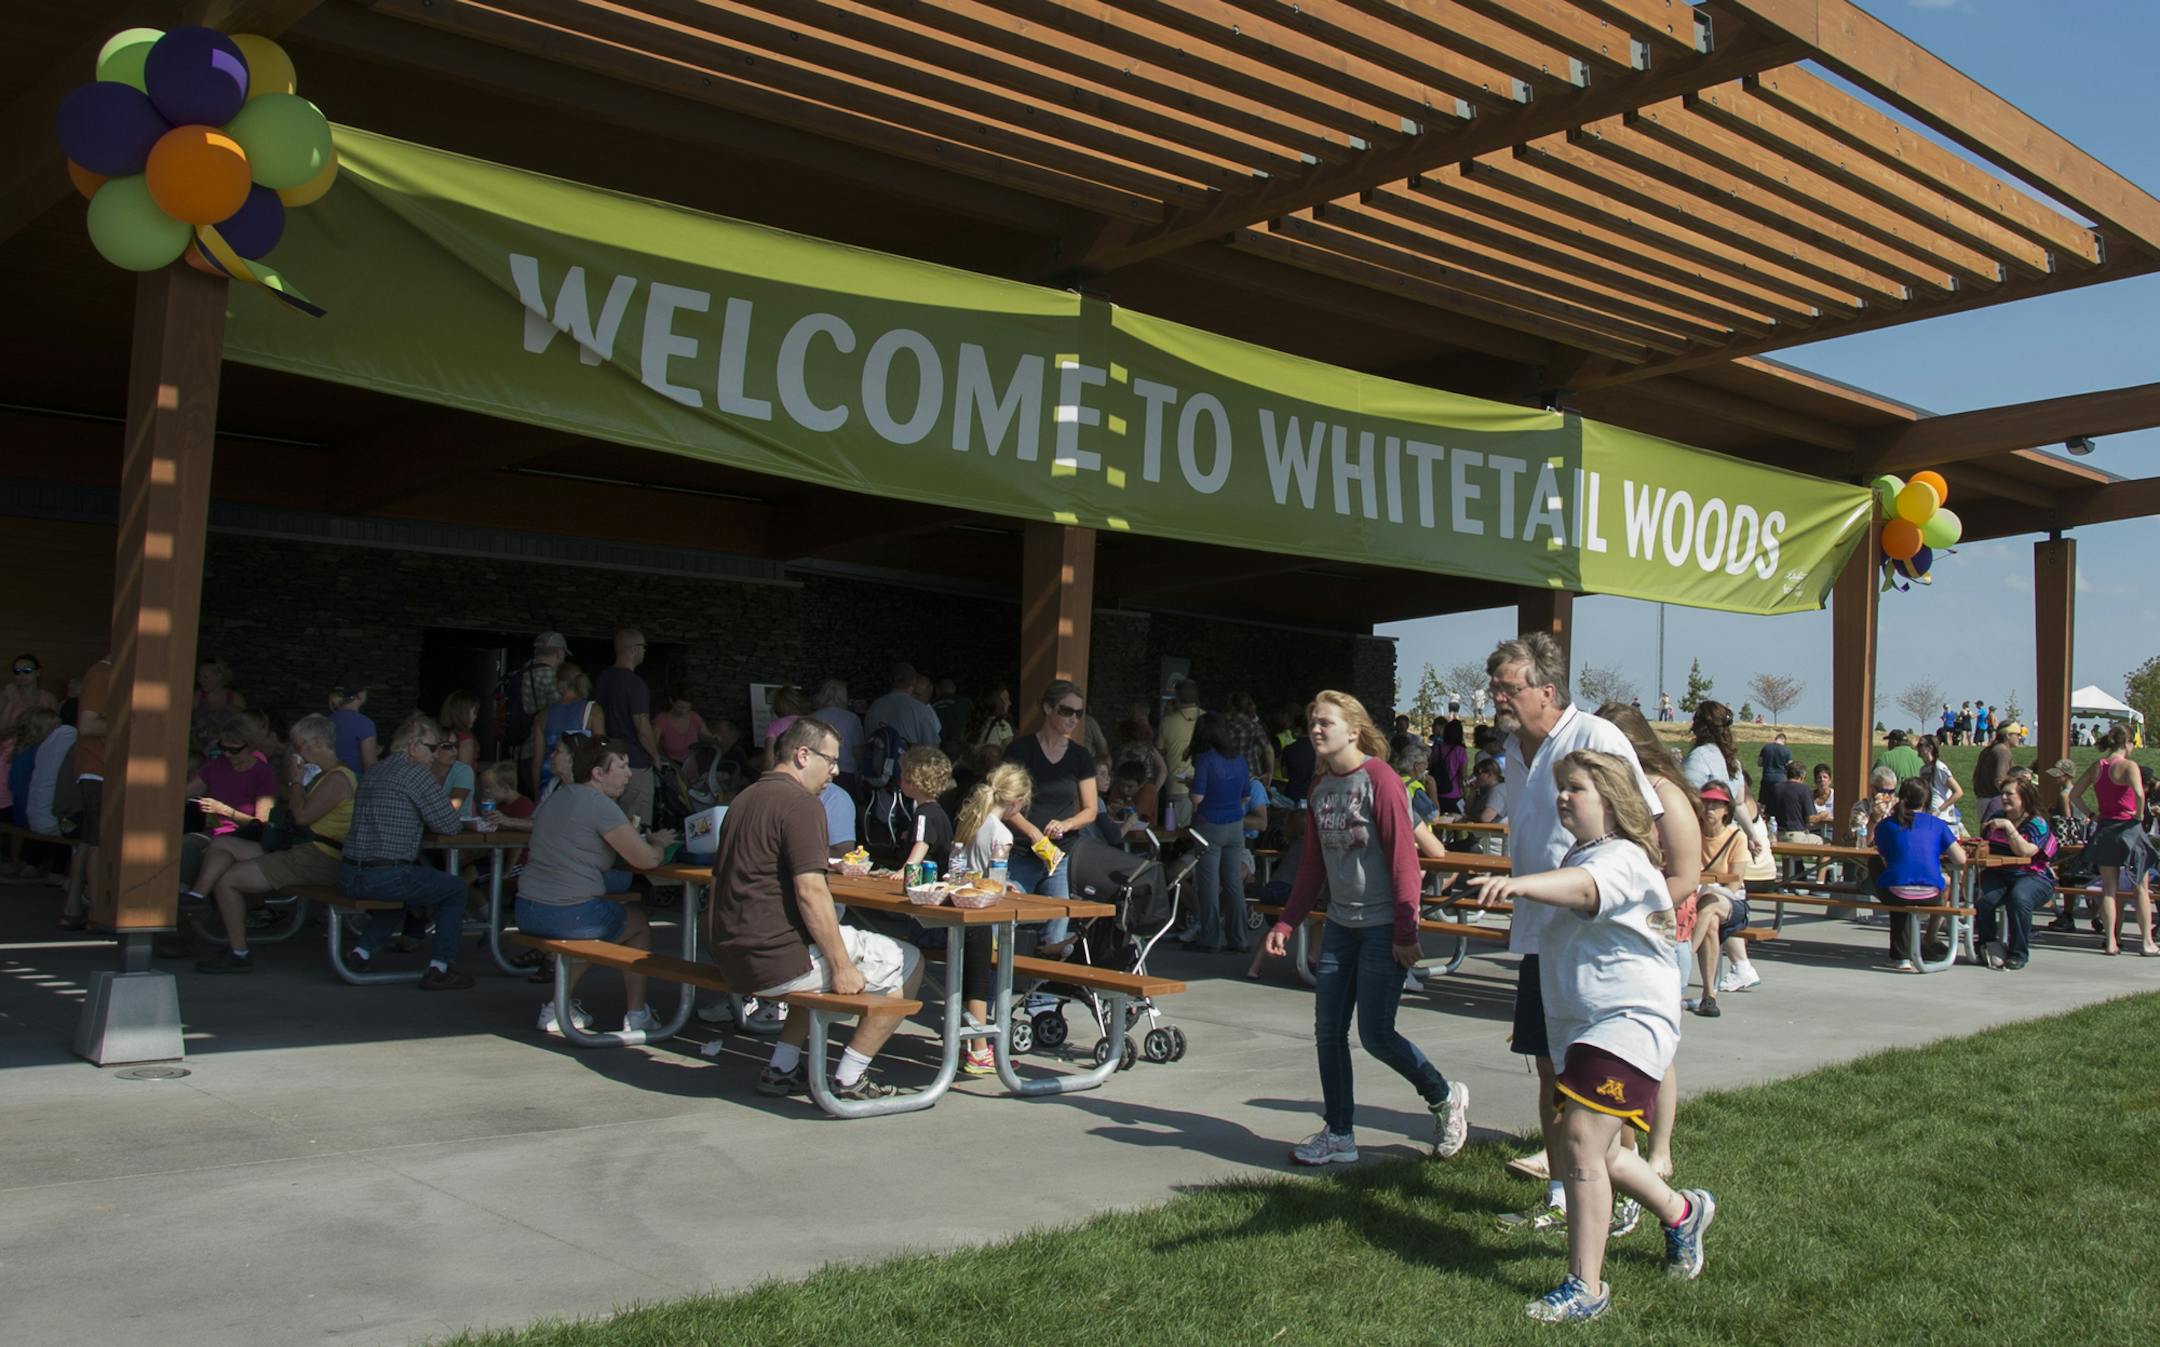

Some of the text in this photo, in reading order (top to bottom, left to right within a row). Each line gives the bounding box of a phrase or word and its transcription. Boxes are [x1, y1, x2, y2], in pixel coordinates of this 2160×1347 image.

[509, 253, 1786, 580] WELCOME TO WHITETAIL WOODS
